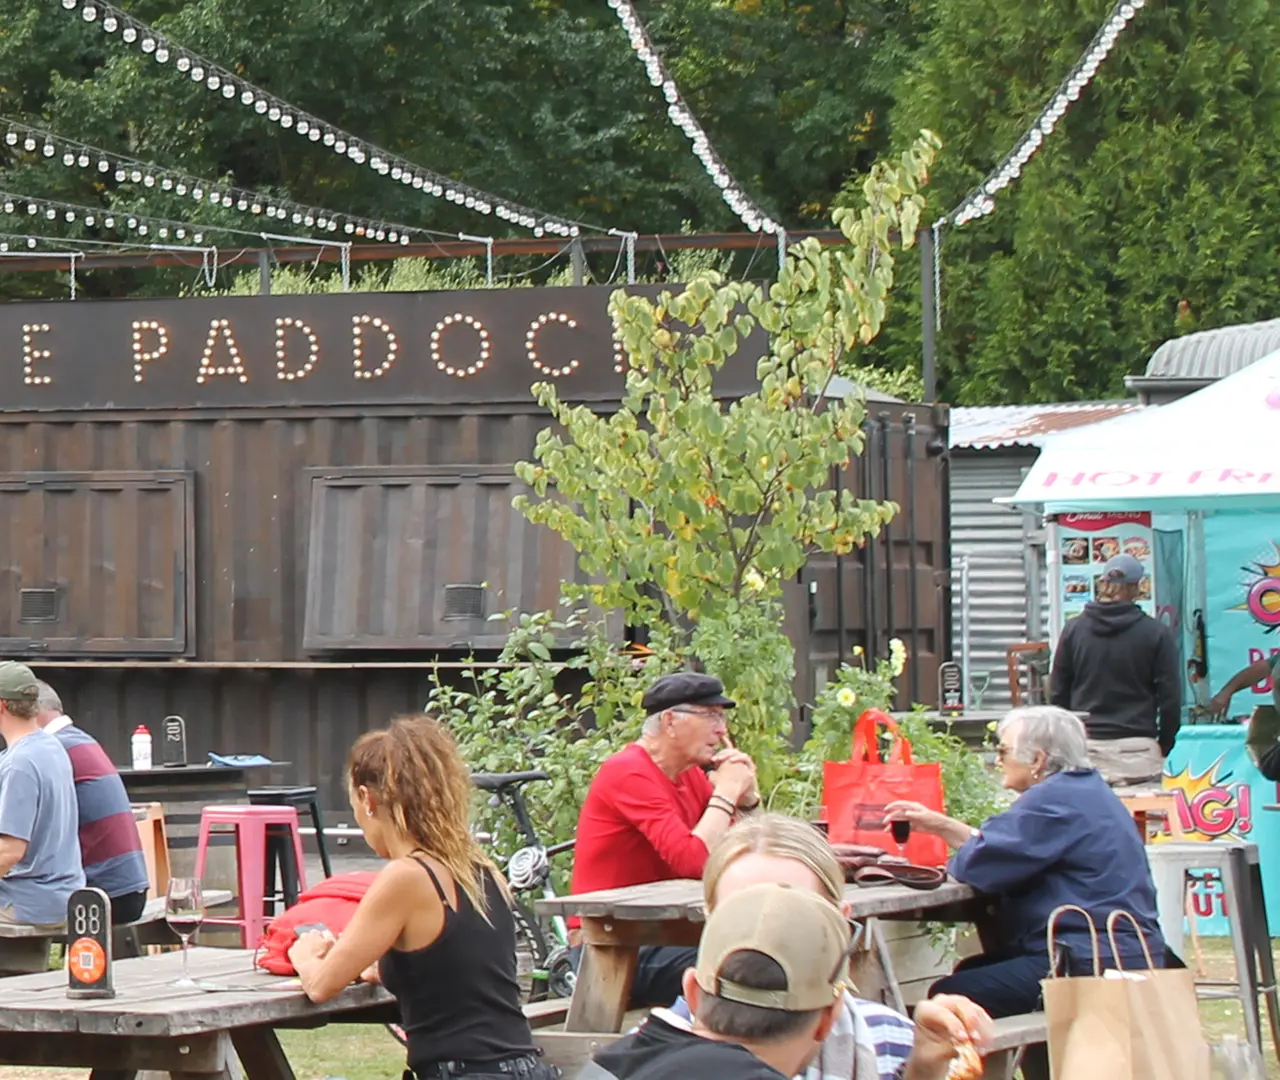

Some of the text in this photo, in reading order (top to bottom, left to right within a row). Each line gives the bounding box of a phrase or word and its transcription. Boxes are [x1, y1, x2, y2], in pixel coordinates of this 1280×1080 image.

[1042, 470, 1171, 488] HOT
[166, 721, 181, 741] 102
[75, 904, 100, 934] 88
